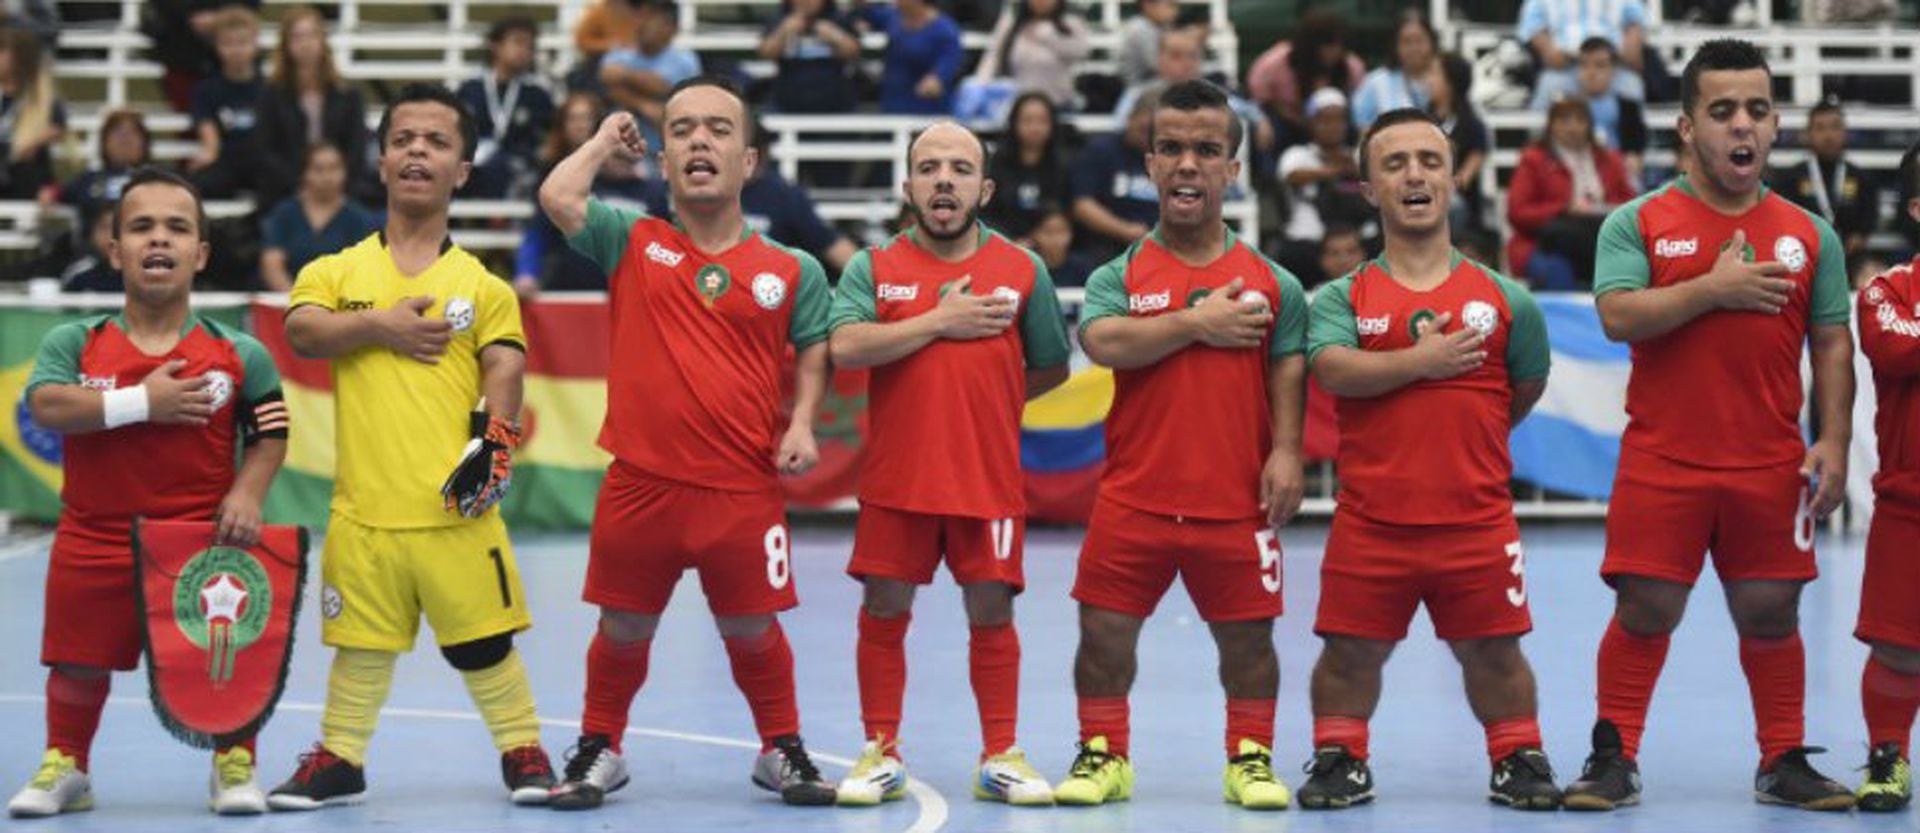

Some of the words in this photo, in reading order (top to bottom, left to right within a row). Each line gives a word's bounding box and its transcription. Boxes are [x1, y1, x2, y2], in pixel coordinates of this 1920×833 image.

[488, 547, 513, 609] 1
[763, 523, 789, 590] 8
[1255, 528, 1281, 593] 5
[1504, 540, 1526, 608] 3
